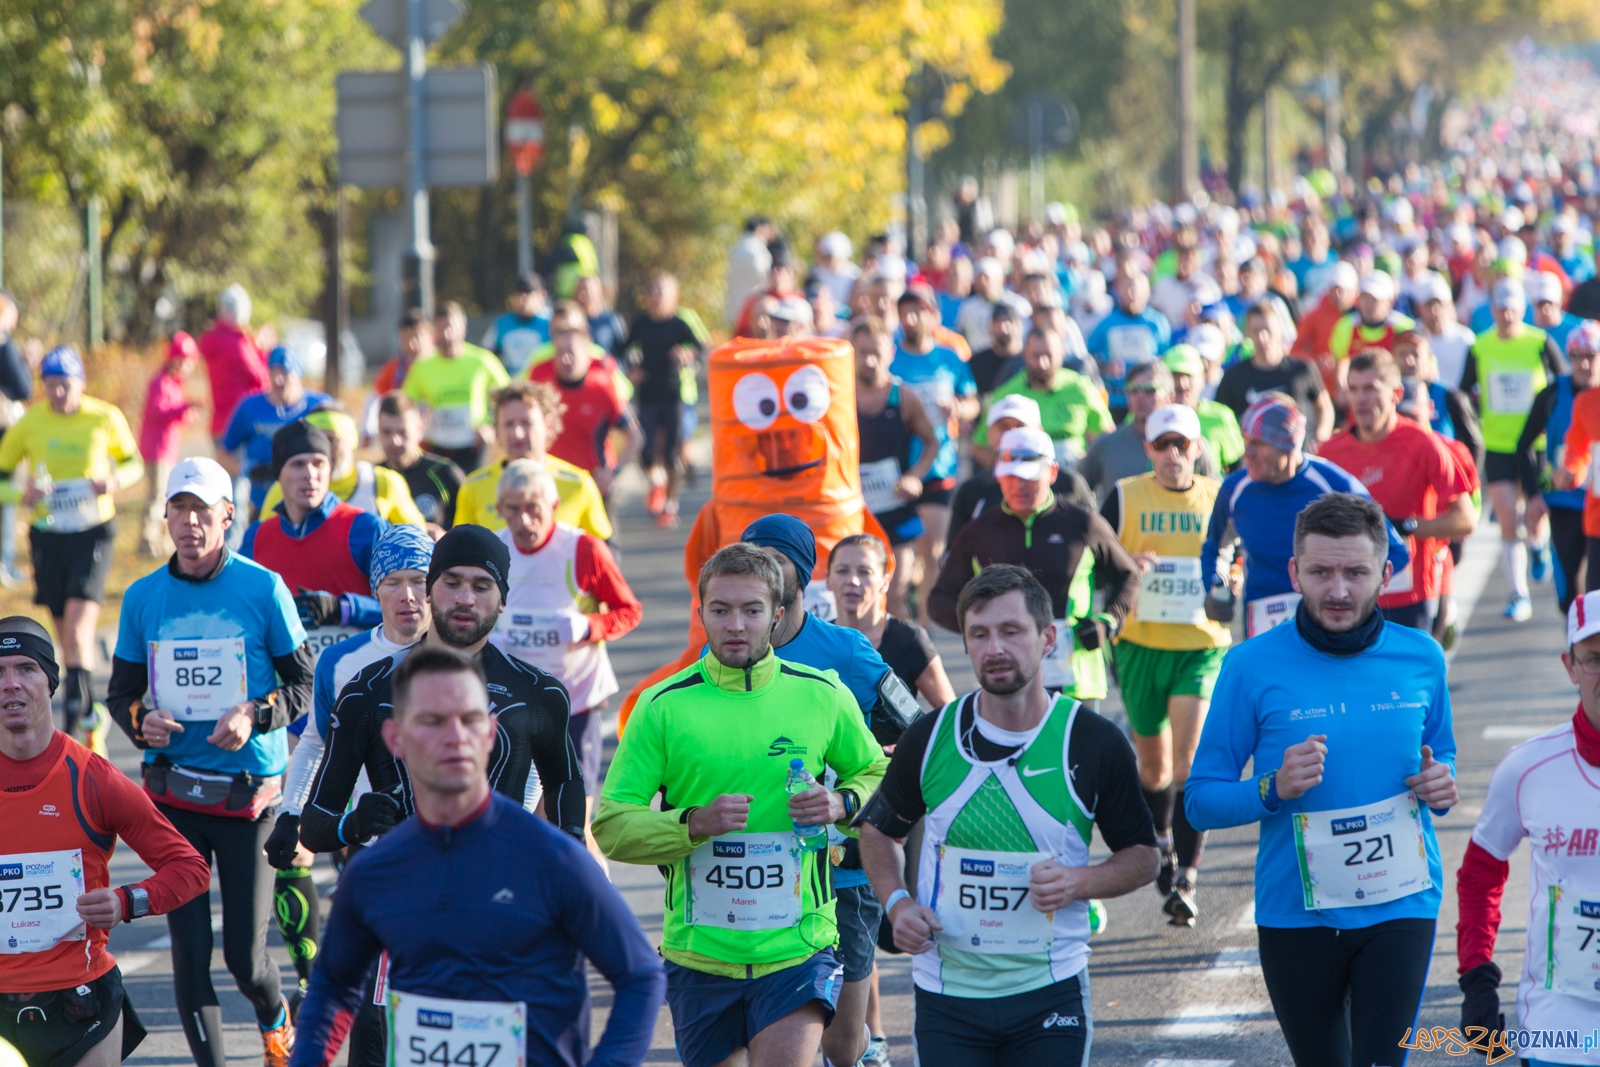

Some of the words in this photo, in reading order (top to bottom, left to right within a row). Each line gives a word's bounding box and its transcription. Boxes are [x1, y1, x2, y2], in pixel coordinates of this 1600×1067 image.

[1146, 579, 1199, 596] 4936
[507, 629, 559, 647] 5268
[176, 666, 222, 687] 862
[725, 845, 743, 854] PKO
[1343, 833, 1394, 867] 221
[1567, 828, 1600, 856] AR
[705, 864, 784, 890] 4503
[0, 885, 64, 913] 735
[731, 897, 757, 906] Marek
[959, 883, 1030, 912] 6157
[11, 921, 42, 929] Łukasz
[1577, 925, 1600, 953] 7
[409, 1035, 502, 1067] 5447
